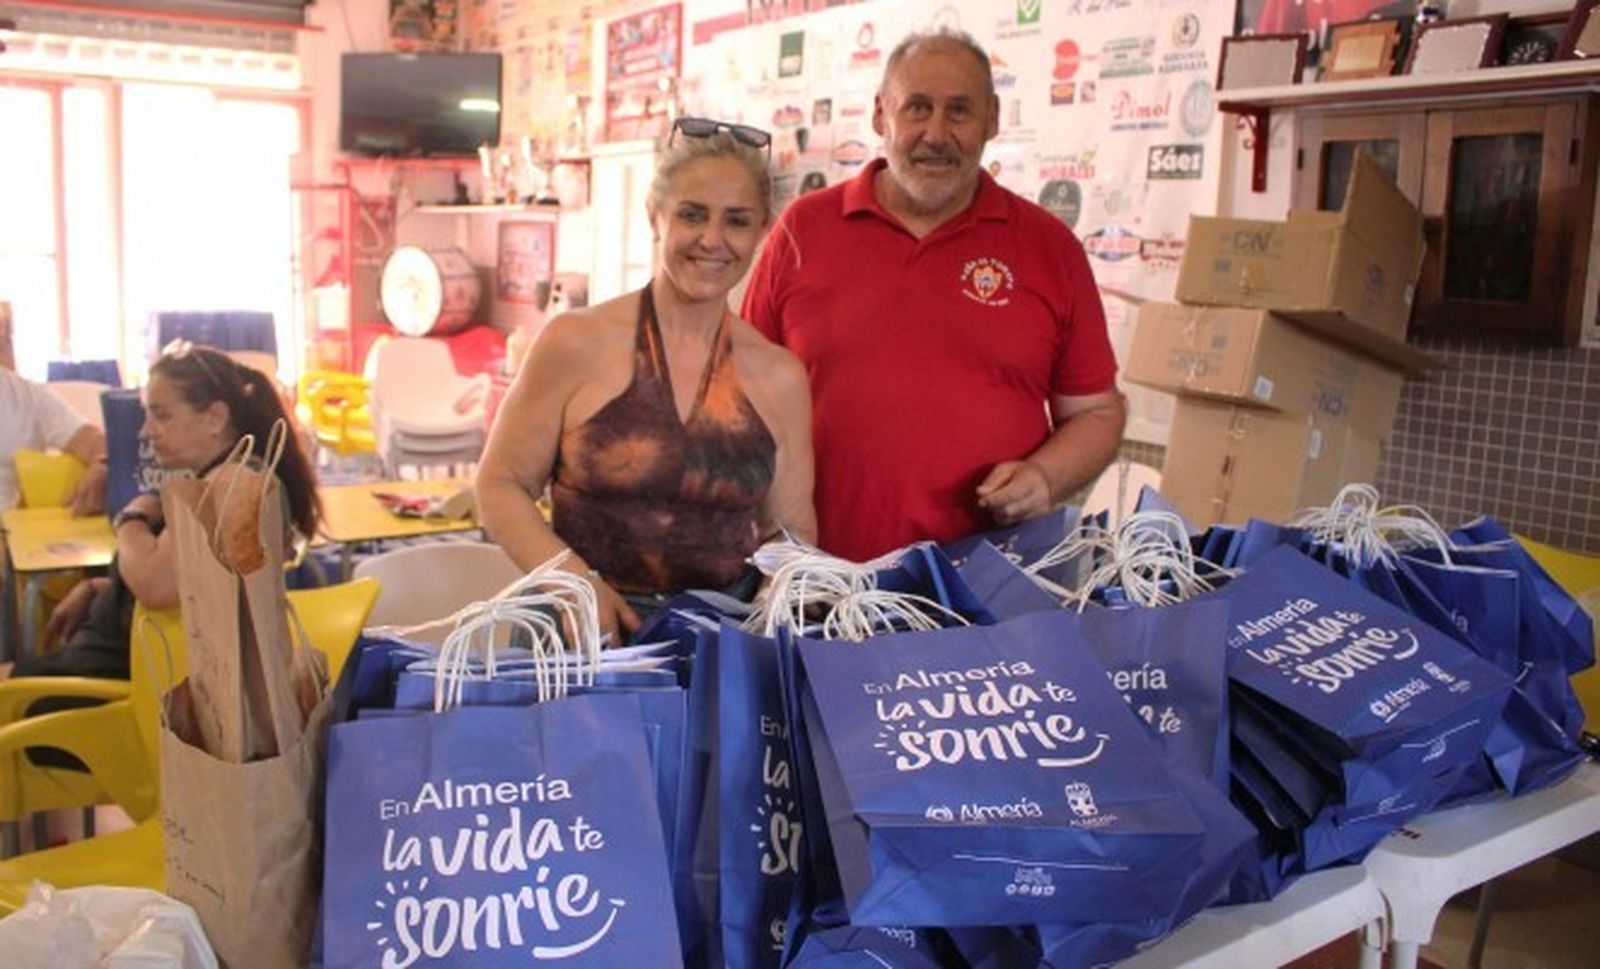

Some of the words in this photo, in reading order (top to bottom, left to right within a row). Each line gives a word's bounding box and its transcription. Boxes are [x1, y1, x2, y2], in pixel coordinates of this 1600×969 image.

[1246, 648, 1287, 665] la
[1276, 616, 1349, 655] vida
[1334, 610, 1367, 625] te
[863, 683, 893, 695] En
[895, 661, 1036, 690] Almería
[1107, 663, 1168, 690] ería
[1295, 627, 1399, 694] sonríe
[876, 699, 916, 722] la
[918, 681, 1043, 719] vida
[1041, 682, 1077, 702] te
[1159, 706, 1182, 734] te
[760, 714, 782, 736] En
[896, 710, 1086, 772] sonríe
[763, 745, 790, 789] la
[379, 799, 411, 821] En
[412, 773, 573, 814] Almería
[960, 797, 1043, 820] Almería
[382, 828, 422, 872] la
[429, 807, 565, 876] vida
[568, 816, 605, 852] te
[381, 866, 600, 969] sonríe
